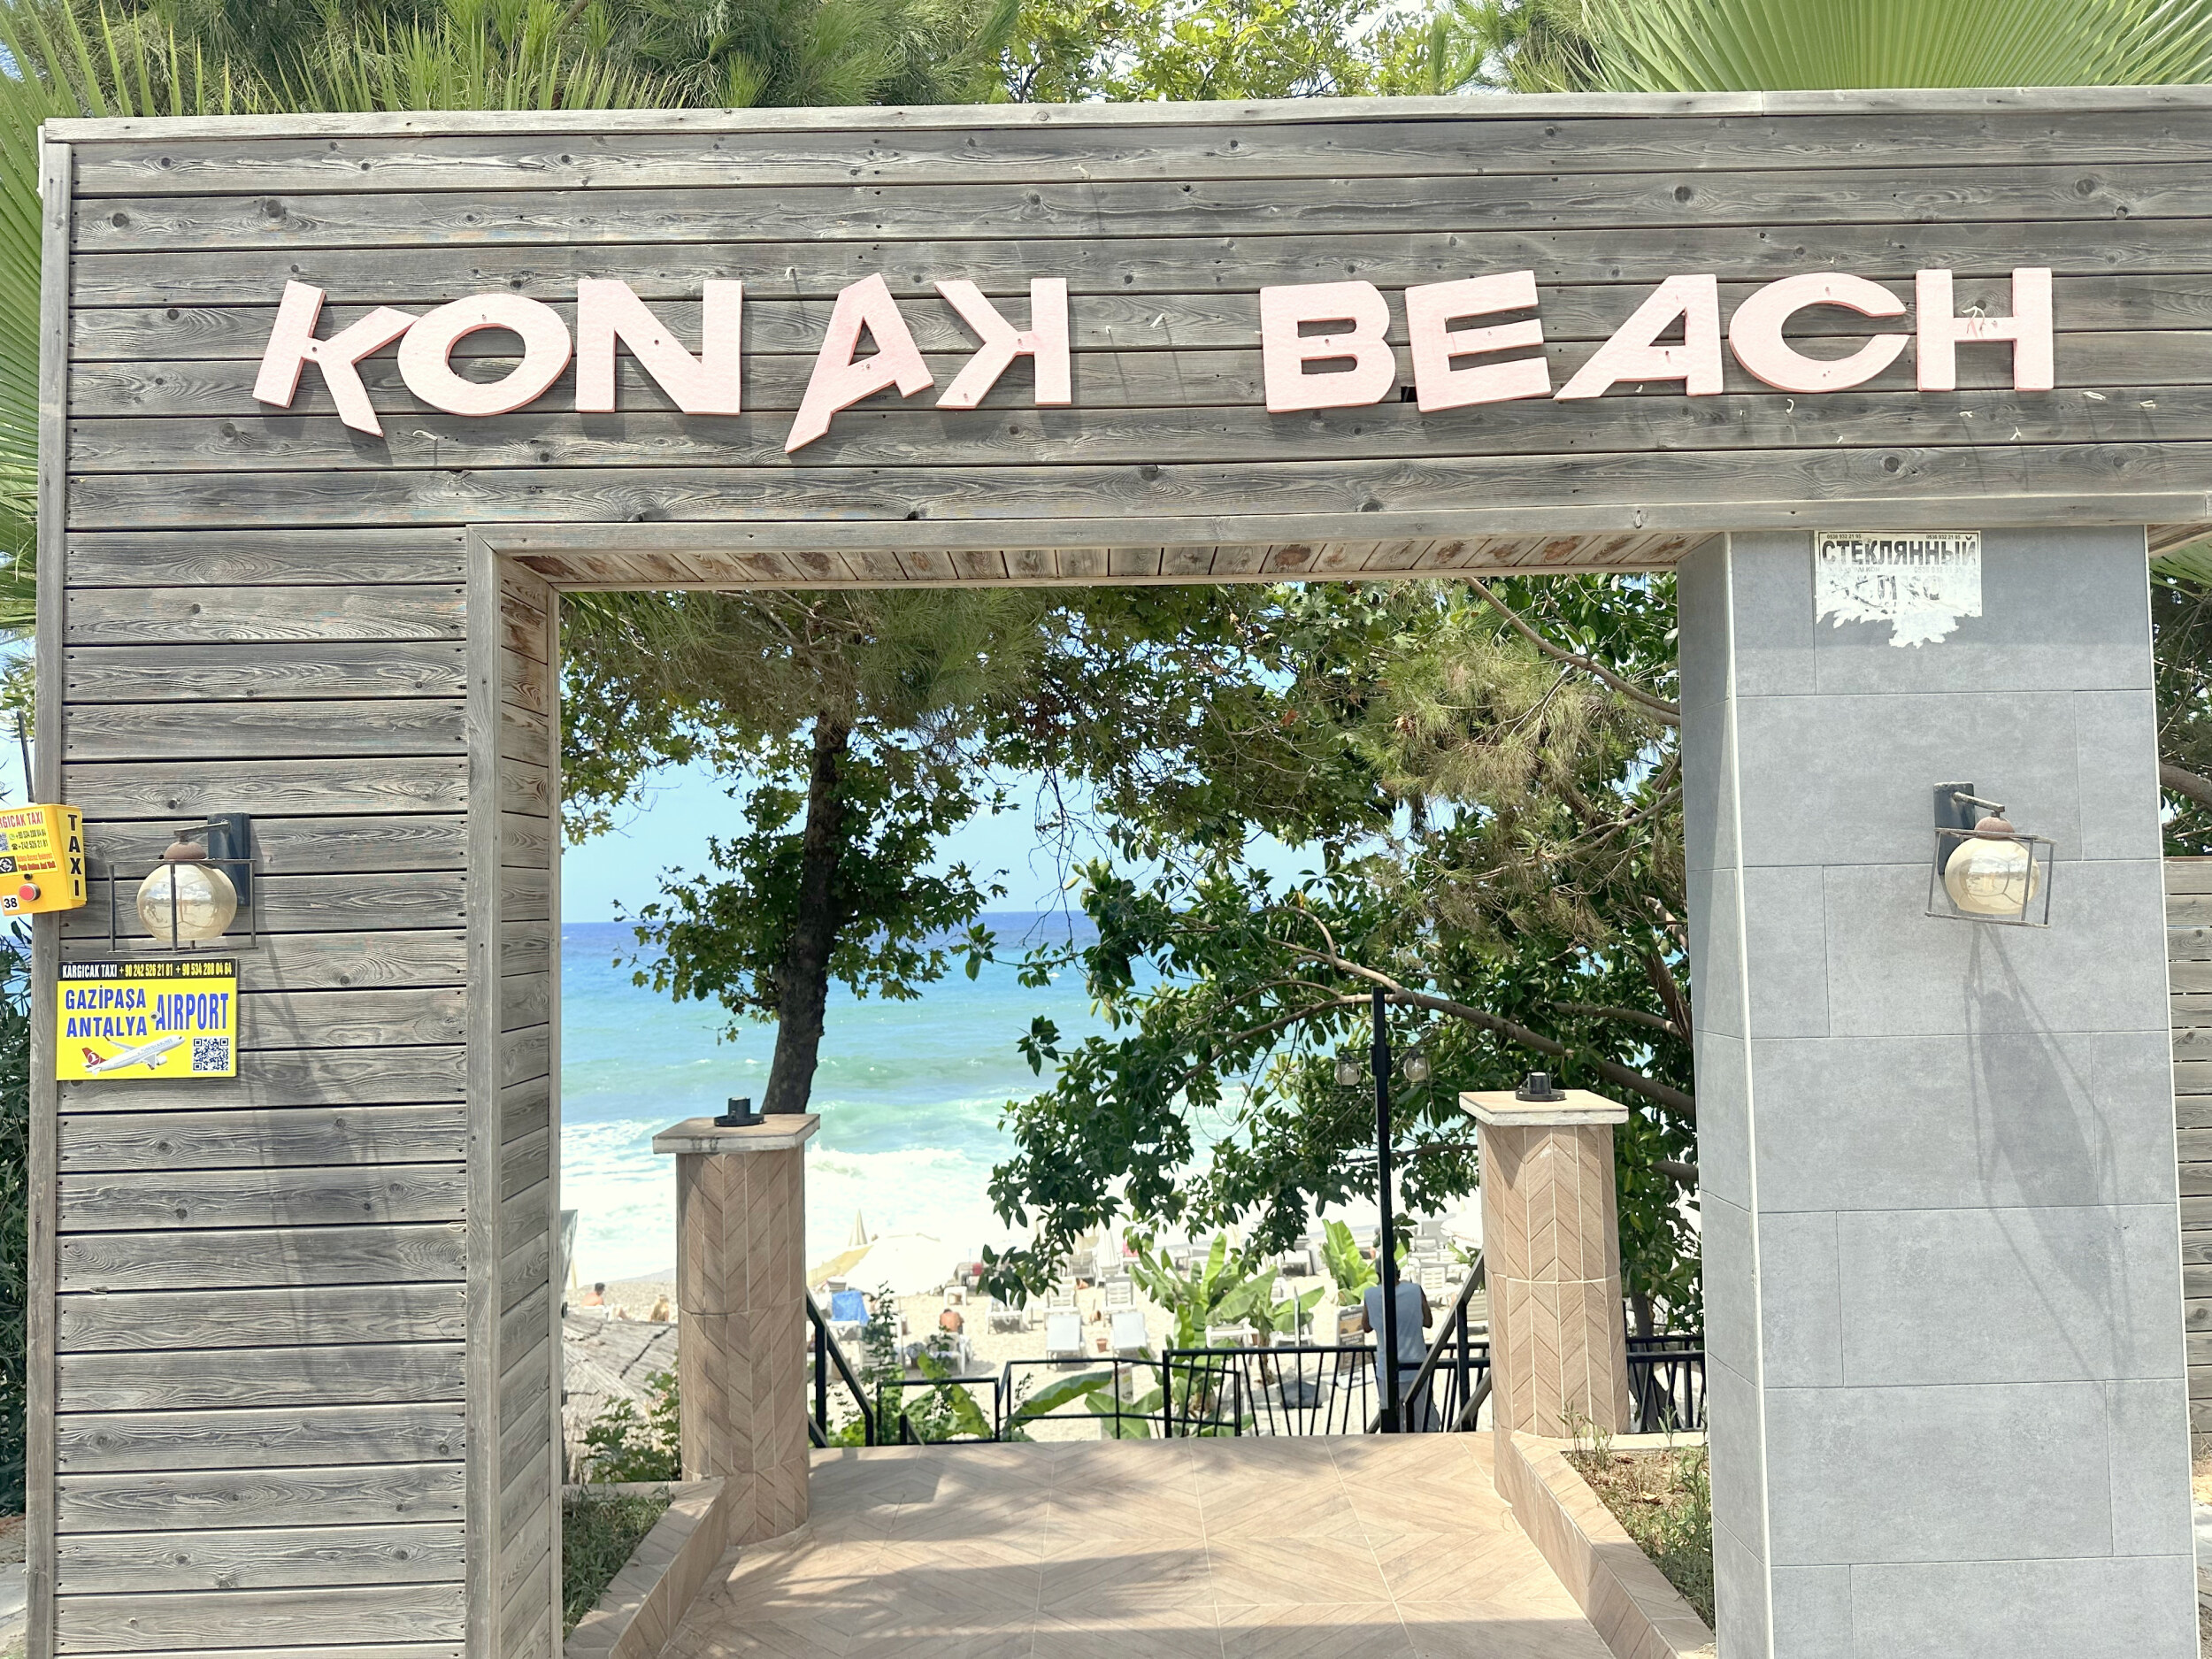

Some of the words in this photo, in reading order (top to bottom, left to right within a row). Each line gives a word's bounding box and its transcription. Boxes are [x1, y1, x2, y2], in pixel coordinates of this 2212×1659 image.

[252, 272, 1072, 454] KONAK
[1259, 267, 2055, 412] BEACH
[1822, 535, 1977, 565] СТЕКЛЯННЫЙ
[27, 811, 43, 826] TAXI
[67, 814, 81, 896] TAXI
[4, 897, 18, 909] 38
[62, 964, 99, 979] KARGICAK
[101, 964, 118, 978] TAXI
[134, 964, 144, 977] 242
[145, 964, 156, 977] 526
[157, 963, 165, 977] 21
[165, 963, 173, 977] 81
[191, 962, 203, 976] 534
[215, 962, 223, 975] 04
[224, 962, 233, 975] 64
[65, 985, 146, 1011] GAZİPAŞA
[155, 993, 229, 1031] AIRPORT
[66, 1017, 148, 1038] ANTALYA
